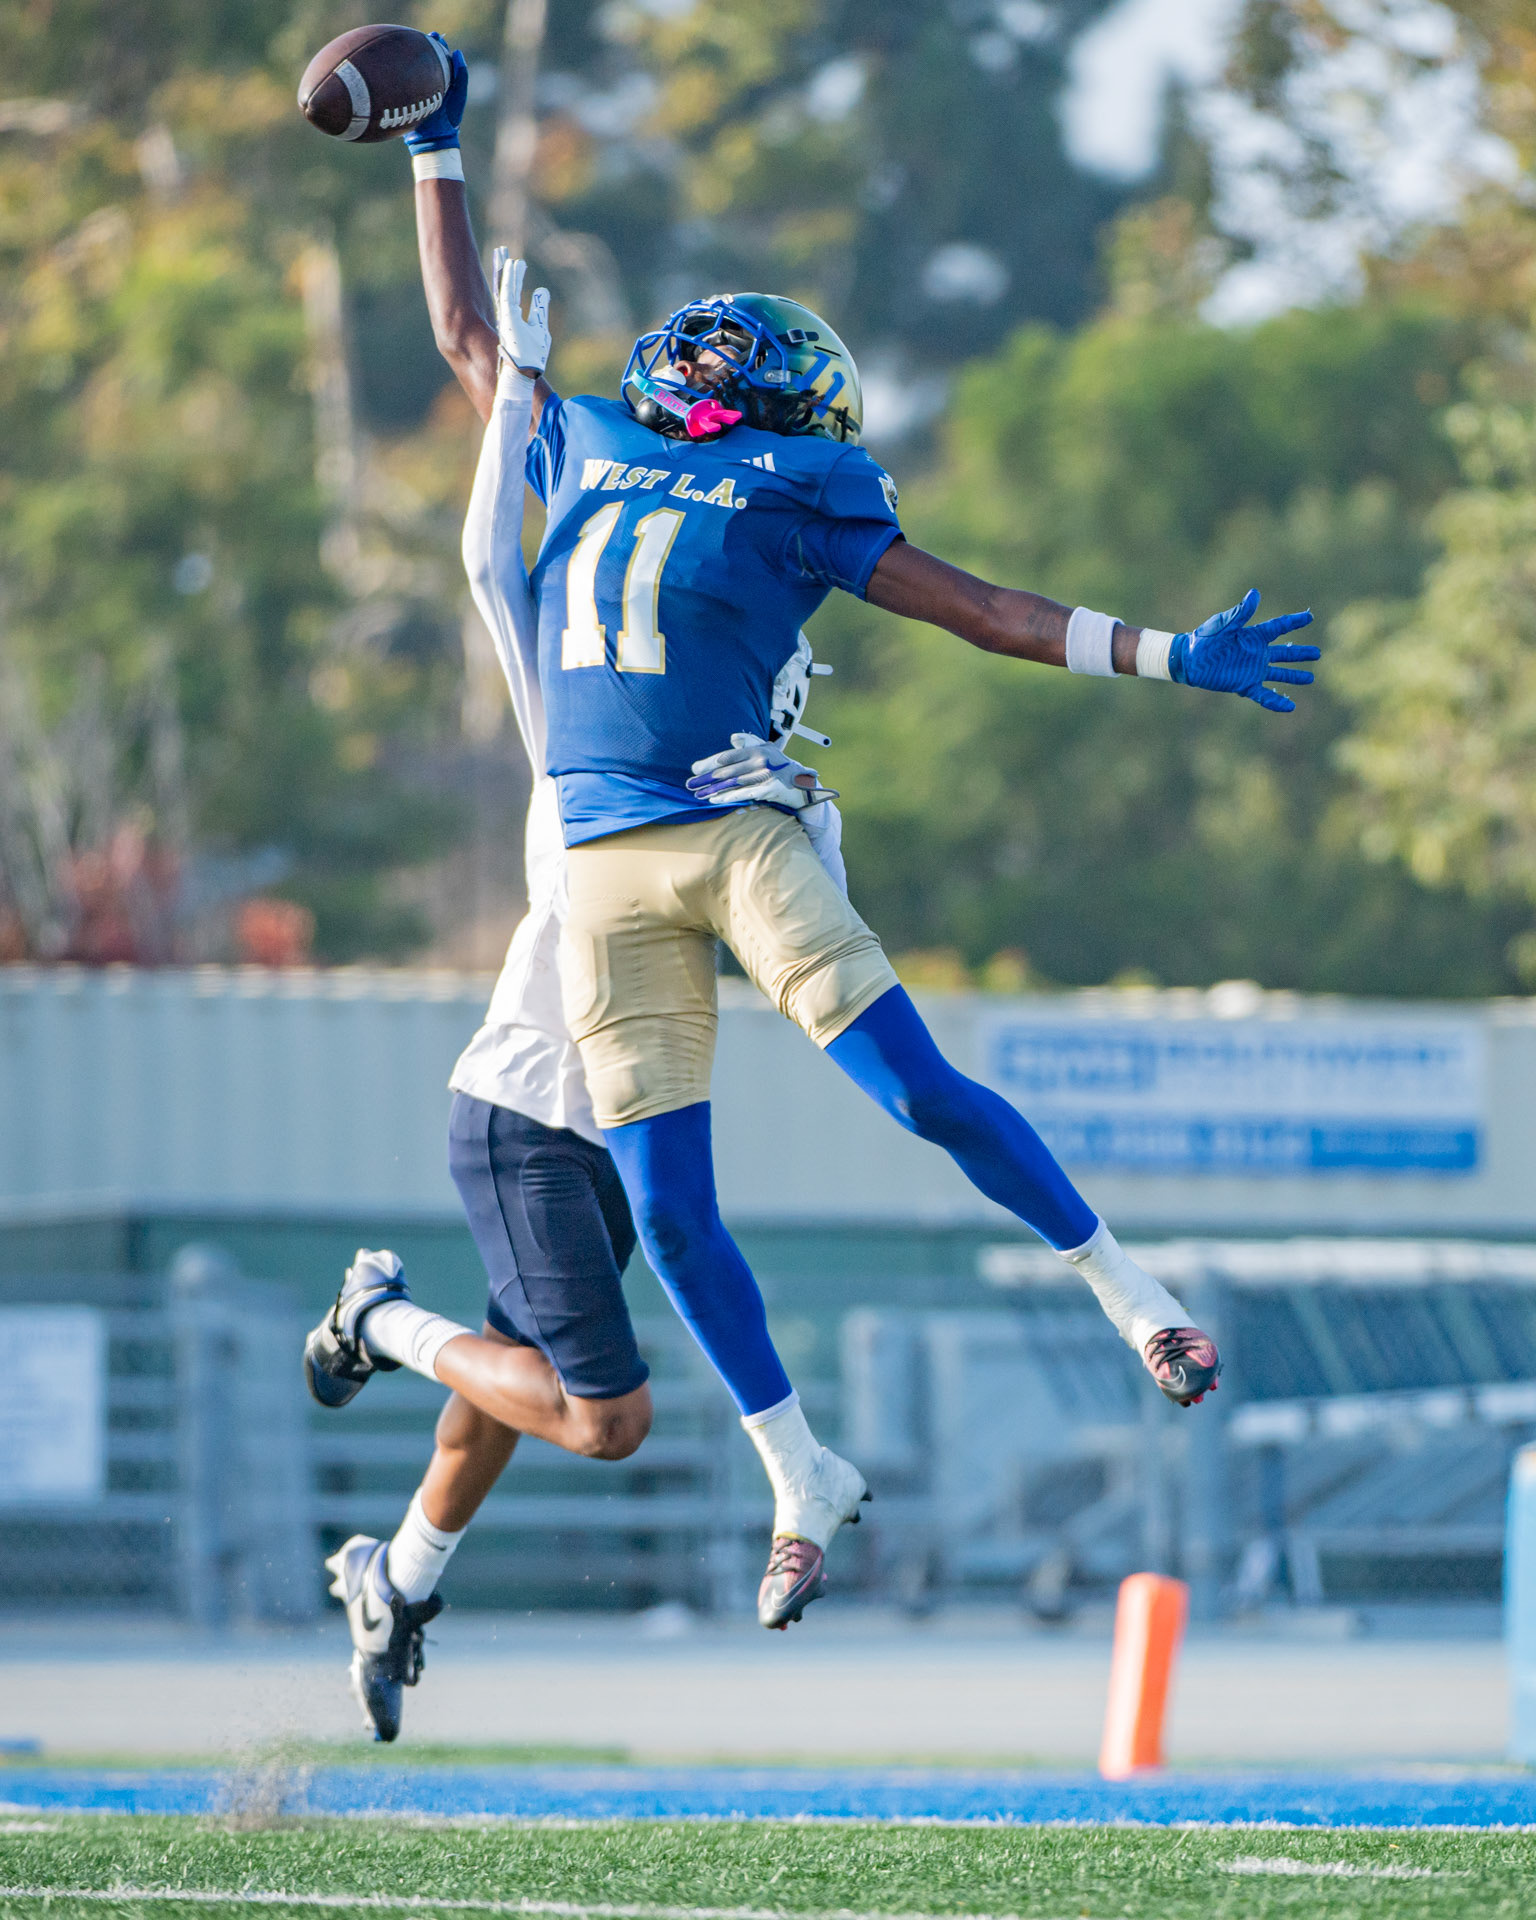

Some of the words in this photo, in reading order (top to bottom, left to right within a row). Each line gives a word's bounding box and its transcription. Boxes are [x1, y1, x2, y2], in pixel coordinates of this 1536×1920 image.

[657, 390, 688, 415] BATTL
[580, 458, 671, 491] WEST
[669, 474, 748, 510] L.A.
[561, 500, 687, 675] 11
